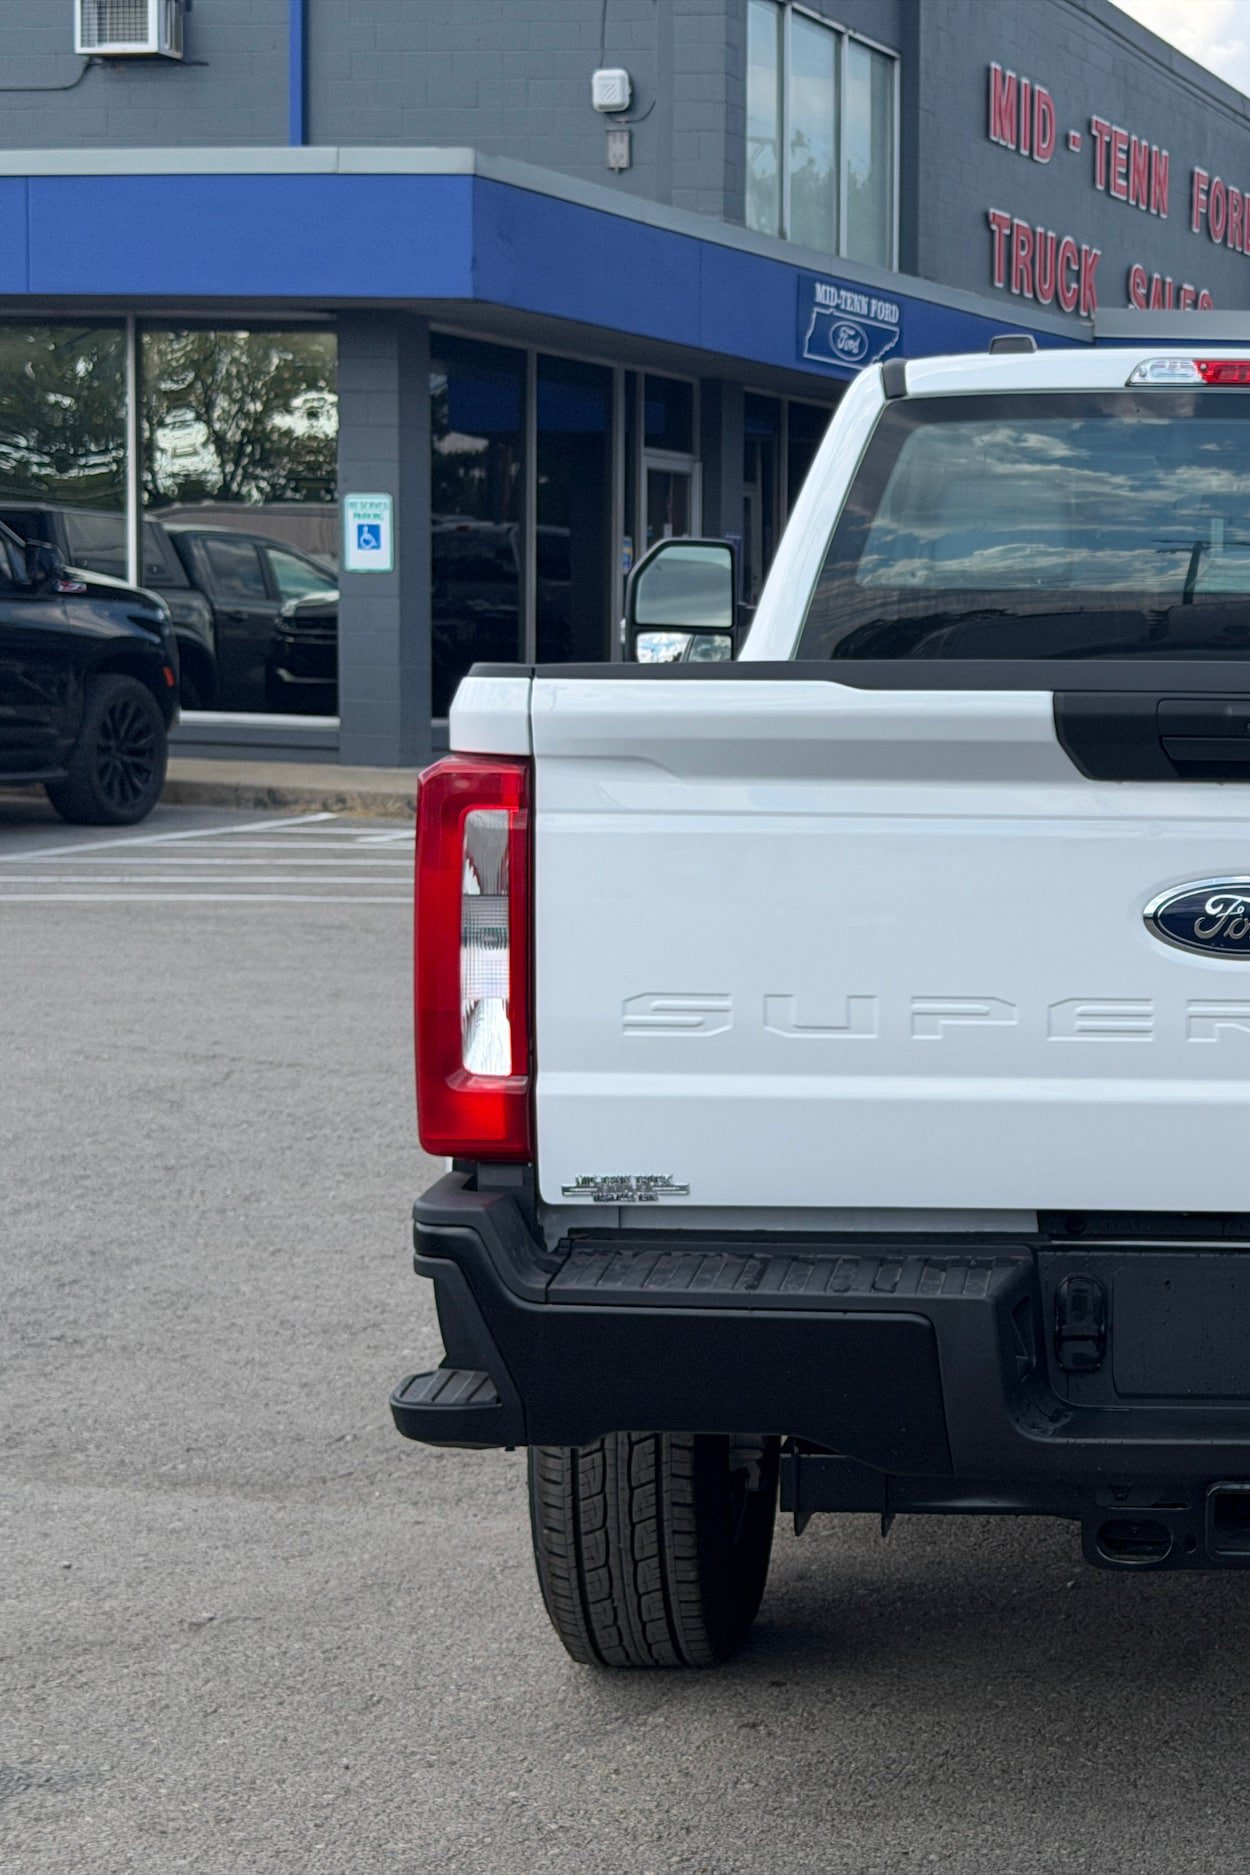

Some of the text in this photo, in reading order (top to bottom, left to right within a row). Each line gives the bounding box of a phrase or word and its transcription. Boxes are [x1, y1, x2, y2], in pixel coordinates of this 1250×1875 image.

[989, 208, 1101, 318] TRUCK
[815, 282, 900, 324] MID-TENN FORD
[836, 326, 862, 354] Ford
